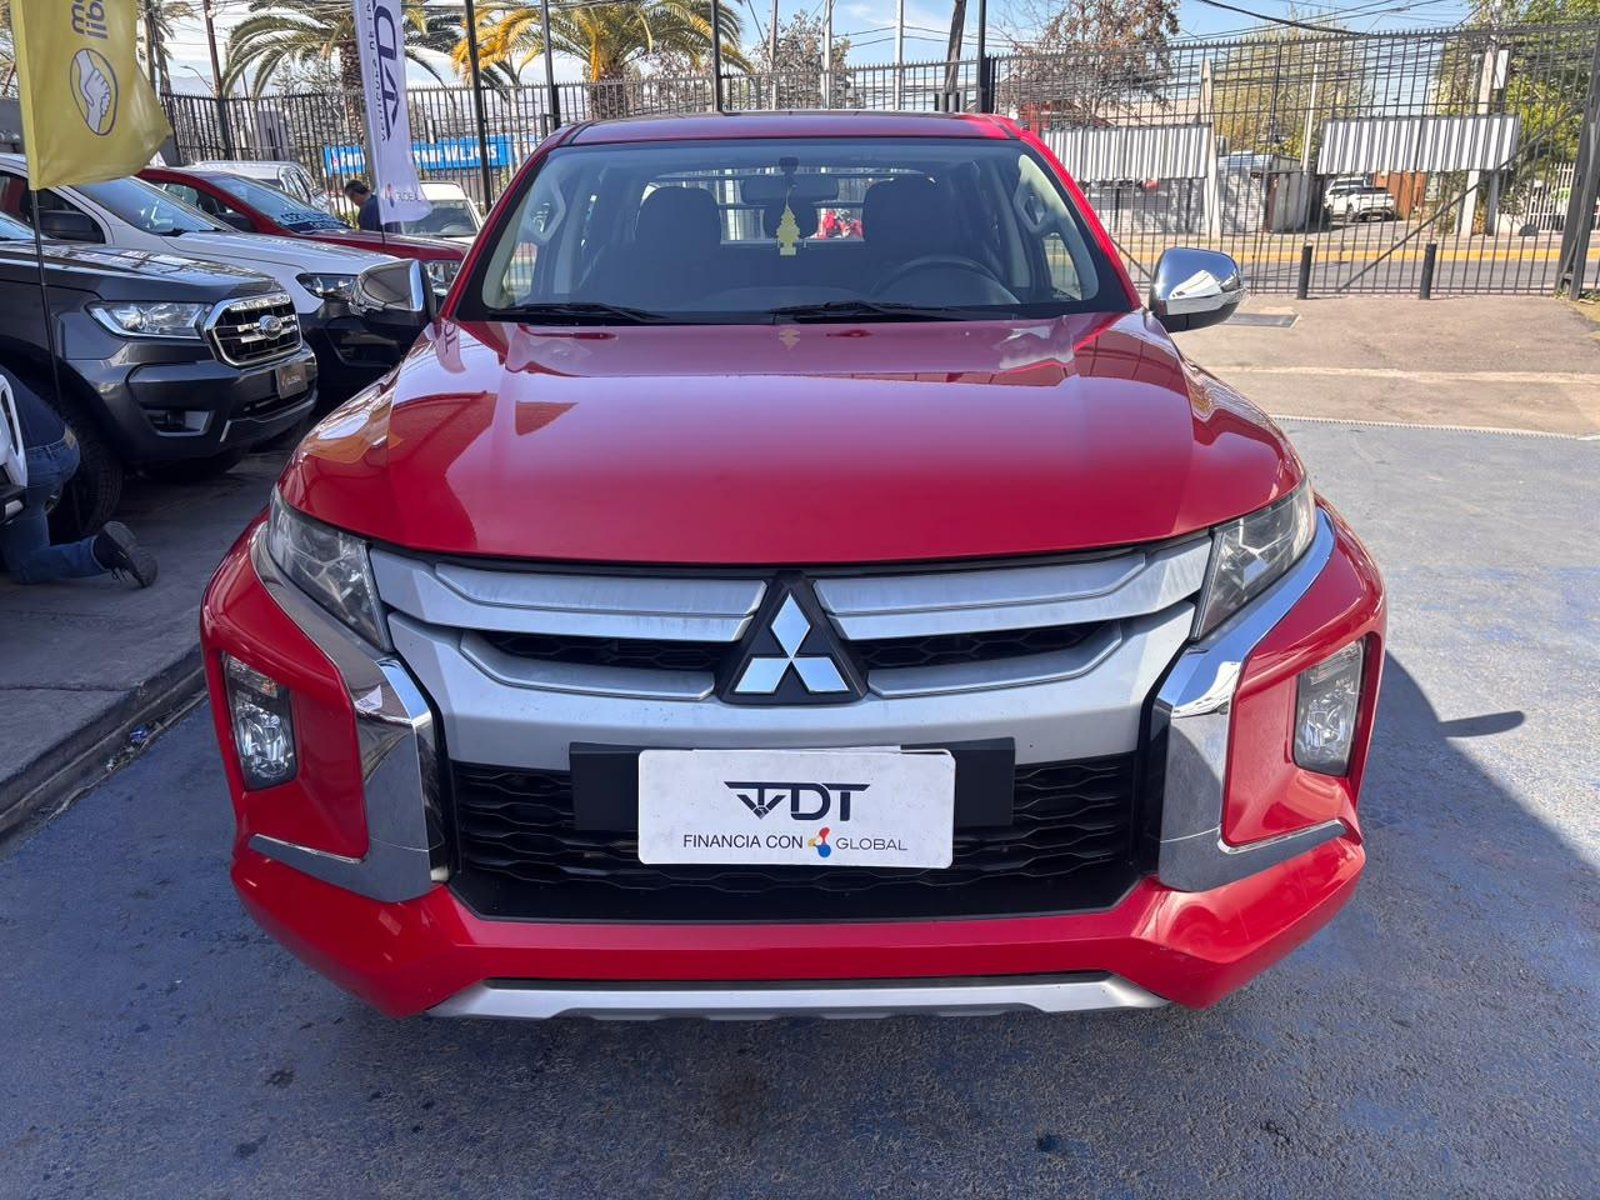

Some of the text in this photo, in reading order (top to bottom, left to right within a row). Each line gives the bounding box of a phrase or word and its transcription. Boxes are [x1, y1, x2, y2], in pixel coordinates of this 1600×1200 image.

[683, 834, 908, 851] FINANCIA CON GLOBAL
